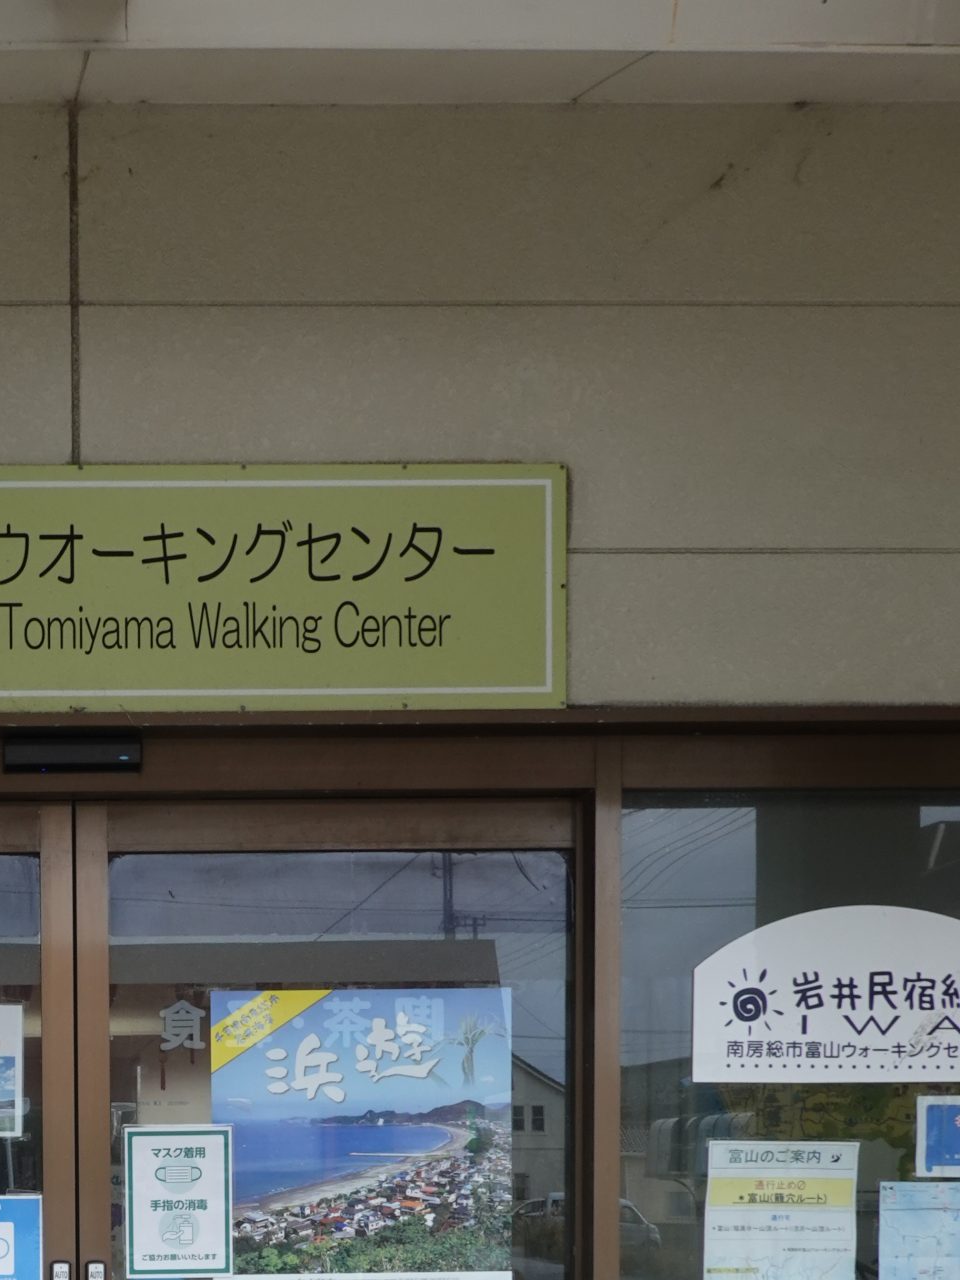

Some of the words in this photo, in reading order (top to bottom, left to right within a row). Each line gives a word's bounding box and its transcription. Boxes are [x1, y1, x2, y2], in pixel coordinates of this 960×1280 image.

[0, 602, 176, 654] Tomiyama
[188, 601, 323, 653] Walking
[334, 600, 452, 649] Center
[151, 1146, 206, 1159] マスク着用
[728, 1149, 821, 1164] 富山のご案内
[150, 1199, 208, 1211] 手指の消毒
[141, 1253, 217, 1261] ご協力お願いいたします
[55, 1271, 67, 1279] AUTO
[90, 1271, 102, 1279] AUTO
